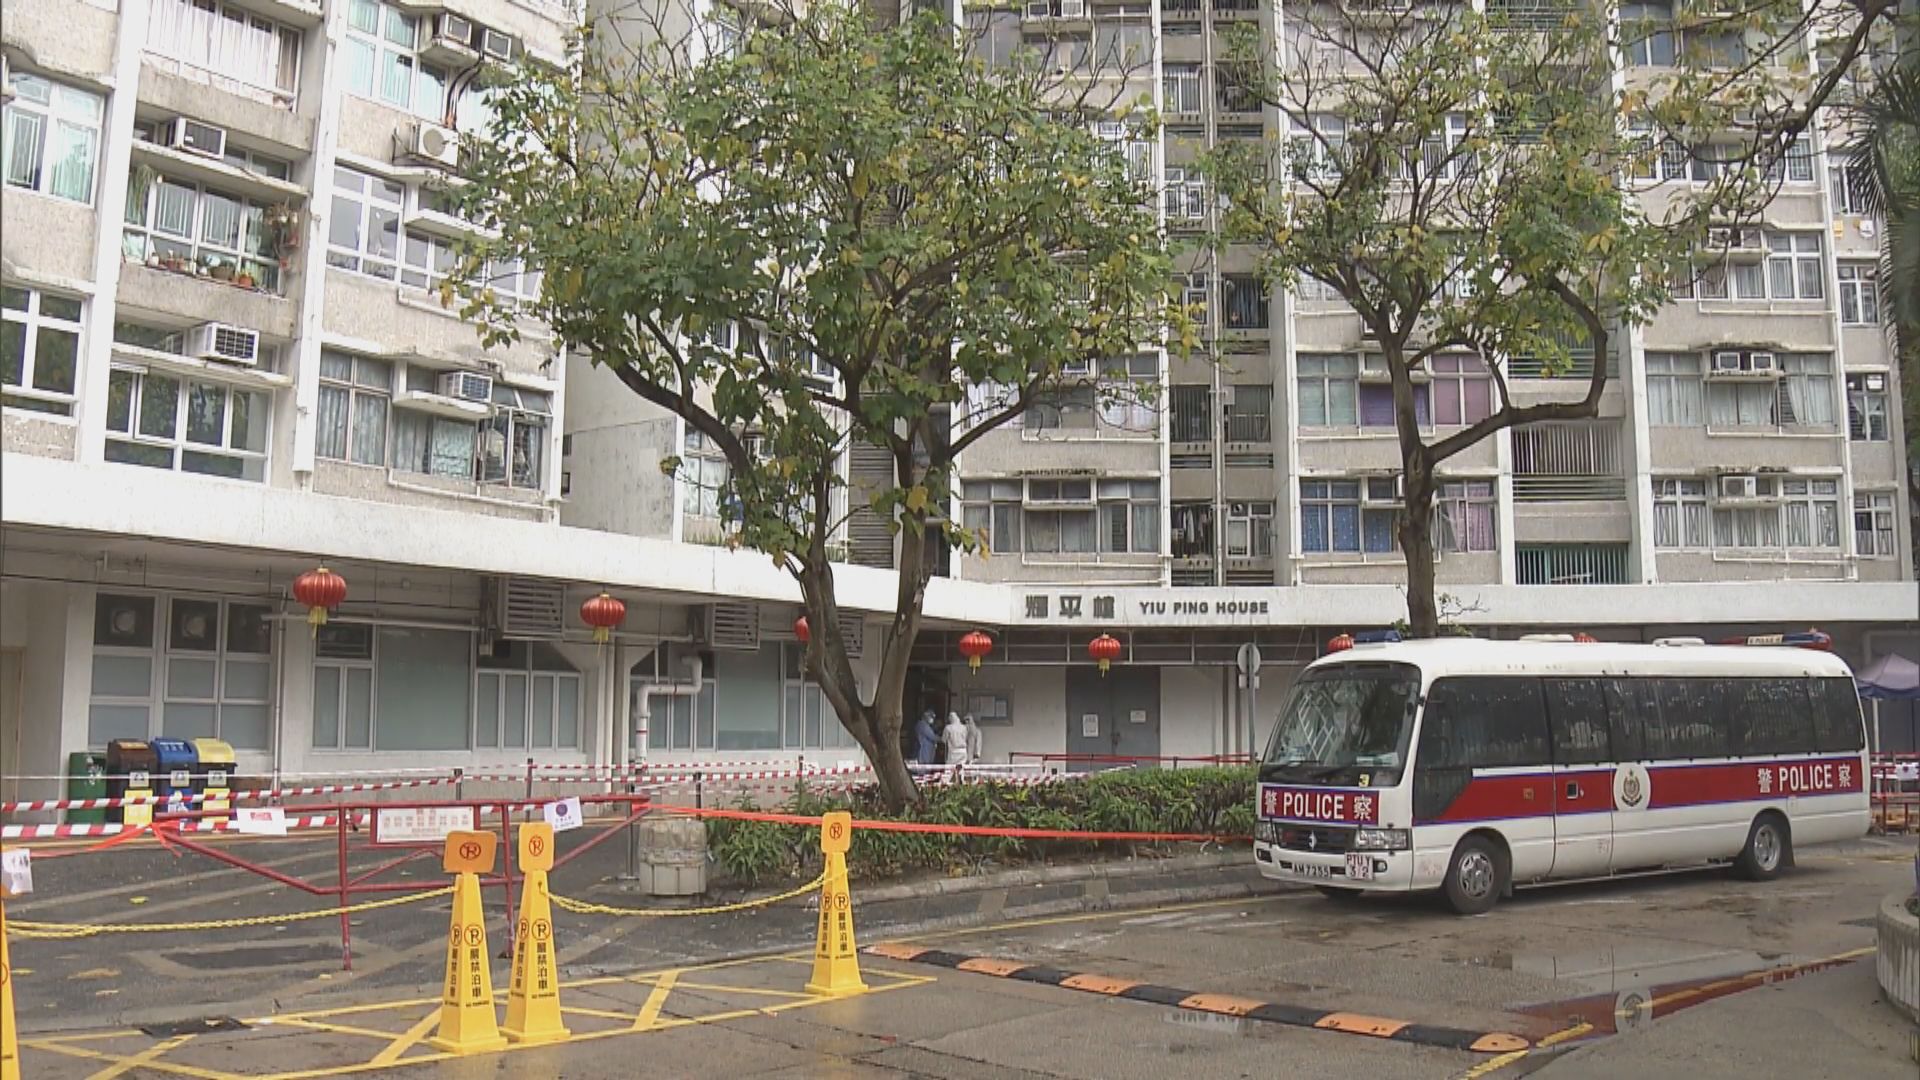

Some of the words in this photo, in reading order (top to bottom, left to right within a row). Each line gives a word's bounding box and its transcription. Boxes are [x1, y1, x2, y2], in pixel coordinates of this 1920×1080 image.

[1139, 601, 1166, 615] YIU
[1173, 601, 1209, 615] PING
[1216, 601, 1269, 614] HOUSE
[1757, 767, 1772, 793] 警
[1778, 764, 1833, 792] POLICE
[1838, 763, 1851, 787] 察
[1265, 790, 1277, 814] 警
[1283, 792, 1345, 819] POLICE
[1353, 794, 1372, 820] 察
